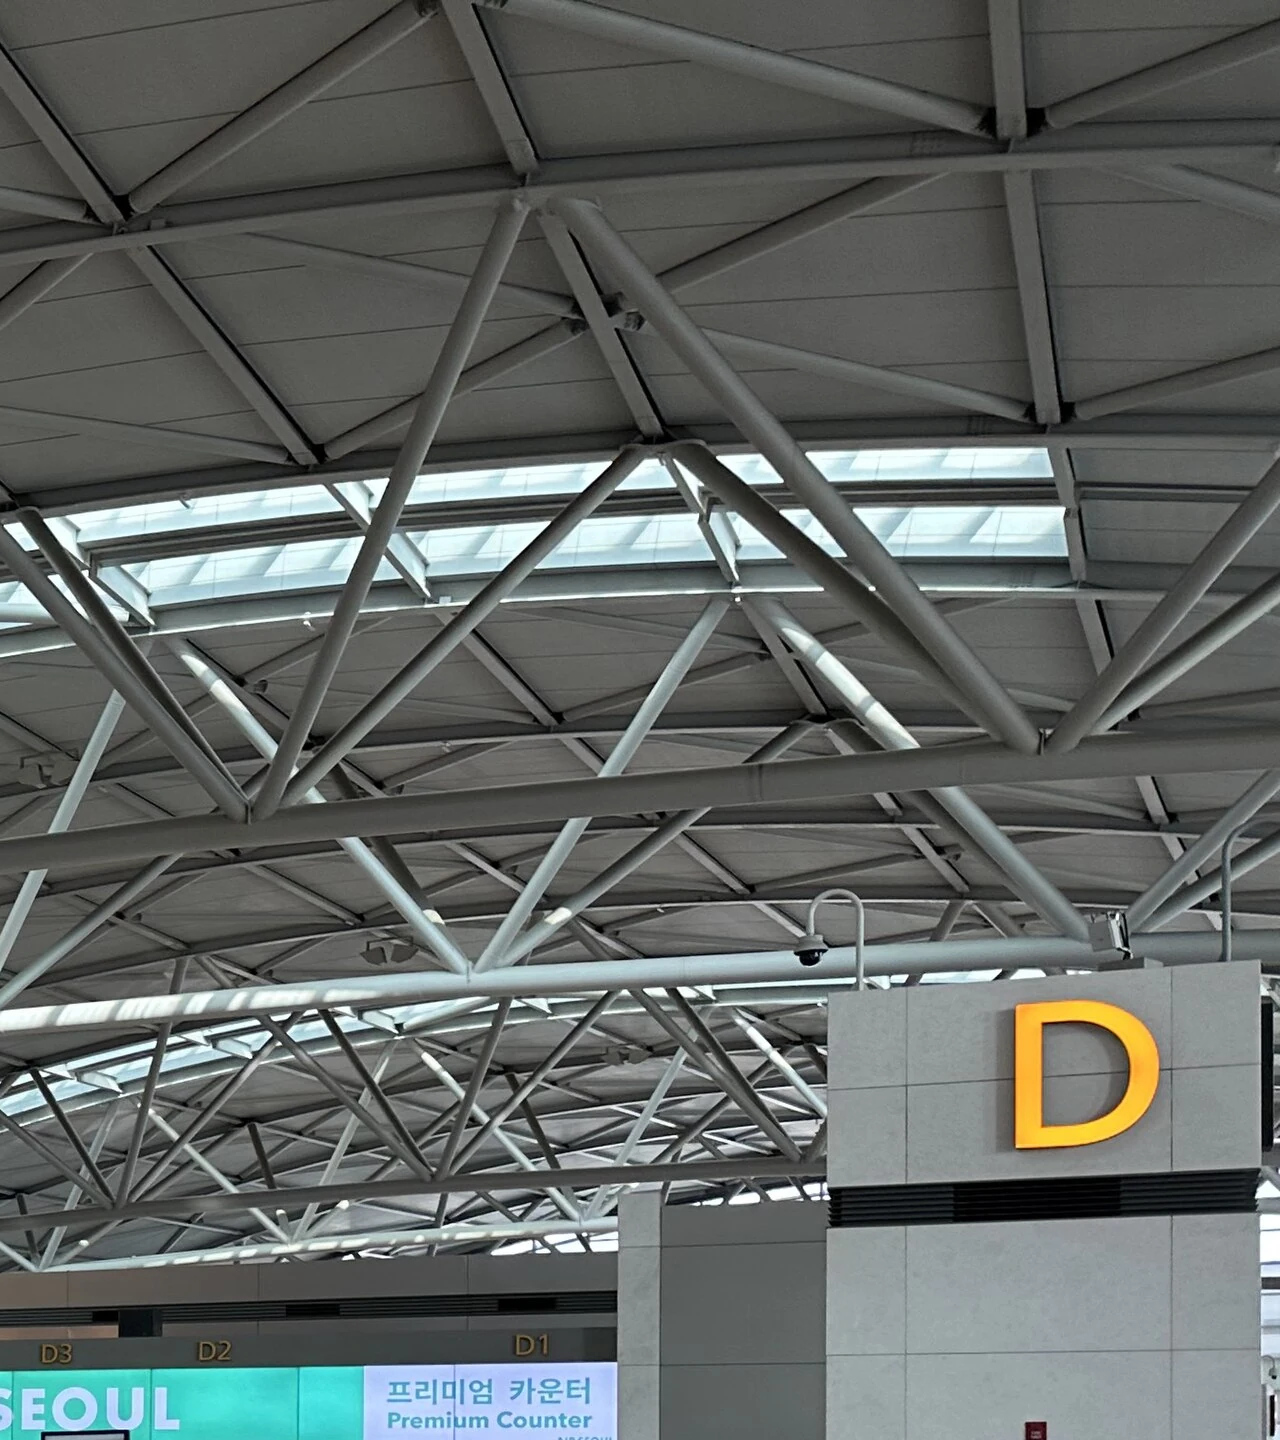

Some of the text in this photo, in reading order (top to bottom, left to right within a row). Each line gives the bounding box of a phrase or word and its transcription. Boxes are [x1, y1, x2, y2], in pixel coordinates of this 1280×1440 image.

[1014, 999, 1160, 1149] D
[41, 1344, 73, 1364] D3
[198, 1341, 232, 1361] D2
[515, 1334, 549, 1356] D1
[387, 1377, 591, 1405] 프리미엄 카운터
[387, 1411, 593, 1429] Premium Counter
